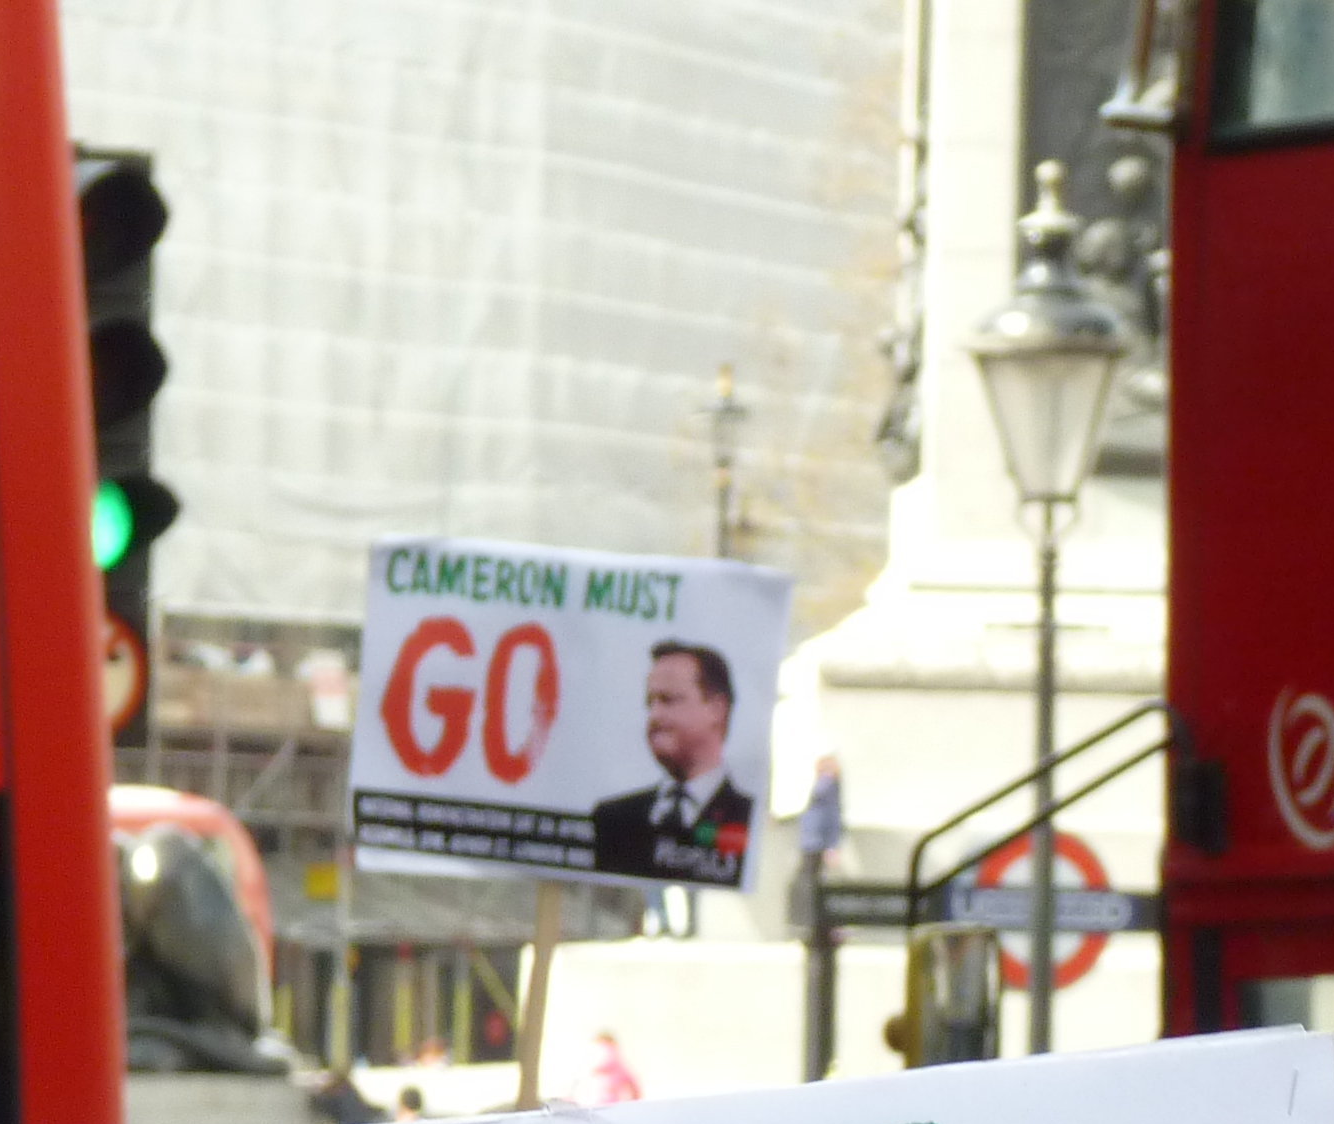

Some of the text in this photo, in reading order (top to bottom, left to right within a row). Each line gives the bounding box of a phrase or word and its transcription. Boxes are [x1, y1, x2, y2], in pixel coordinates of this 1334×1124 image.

[385, 548, 684, 623] CAMERON MUST
[378, 614, 561, 787] GO
